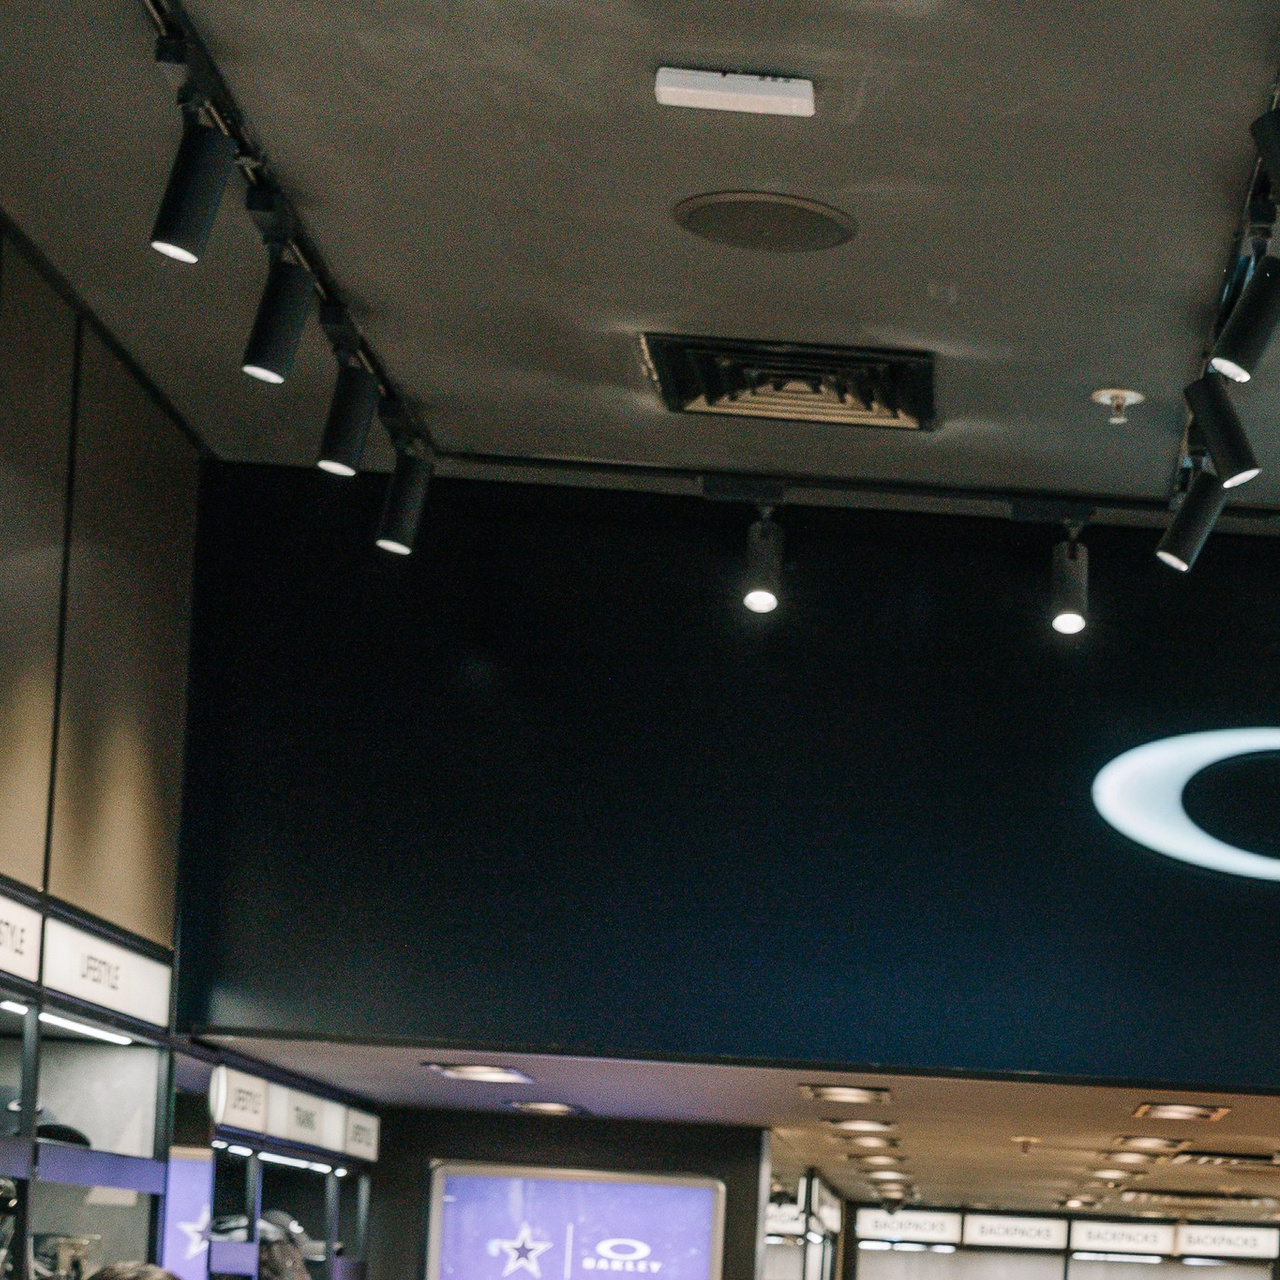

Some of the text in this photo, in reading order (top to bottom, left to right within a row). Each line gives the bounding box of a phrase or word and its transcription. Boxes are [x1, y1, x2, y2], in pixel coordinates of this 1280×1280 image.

[873, 1218, 947, 1233] BACKPACKS
[979, 1224, 1053, 1239] BACKPACKS
[1085, 1230, 1158, 1245] BACKPACKS
[1186, 1234, 1258, 1249] BACKPACKS
[582, 1256, 662, 1273] OAKLEY
